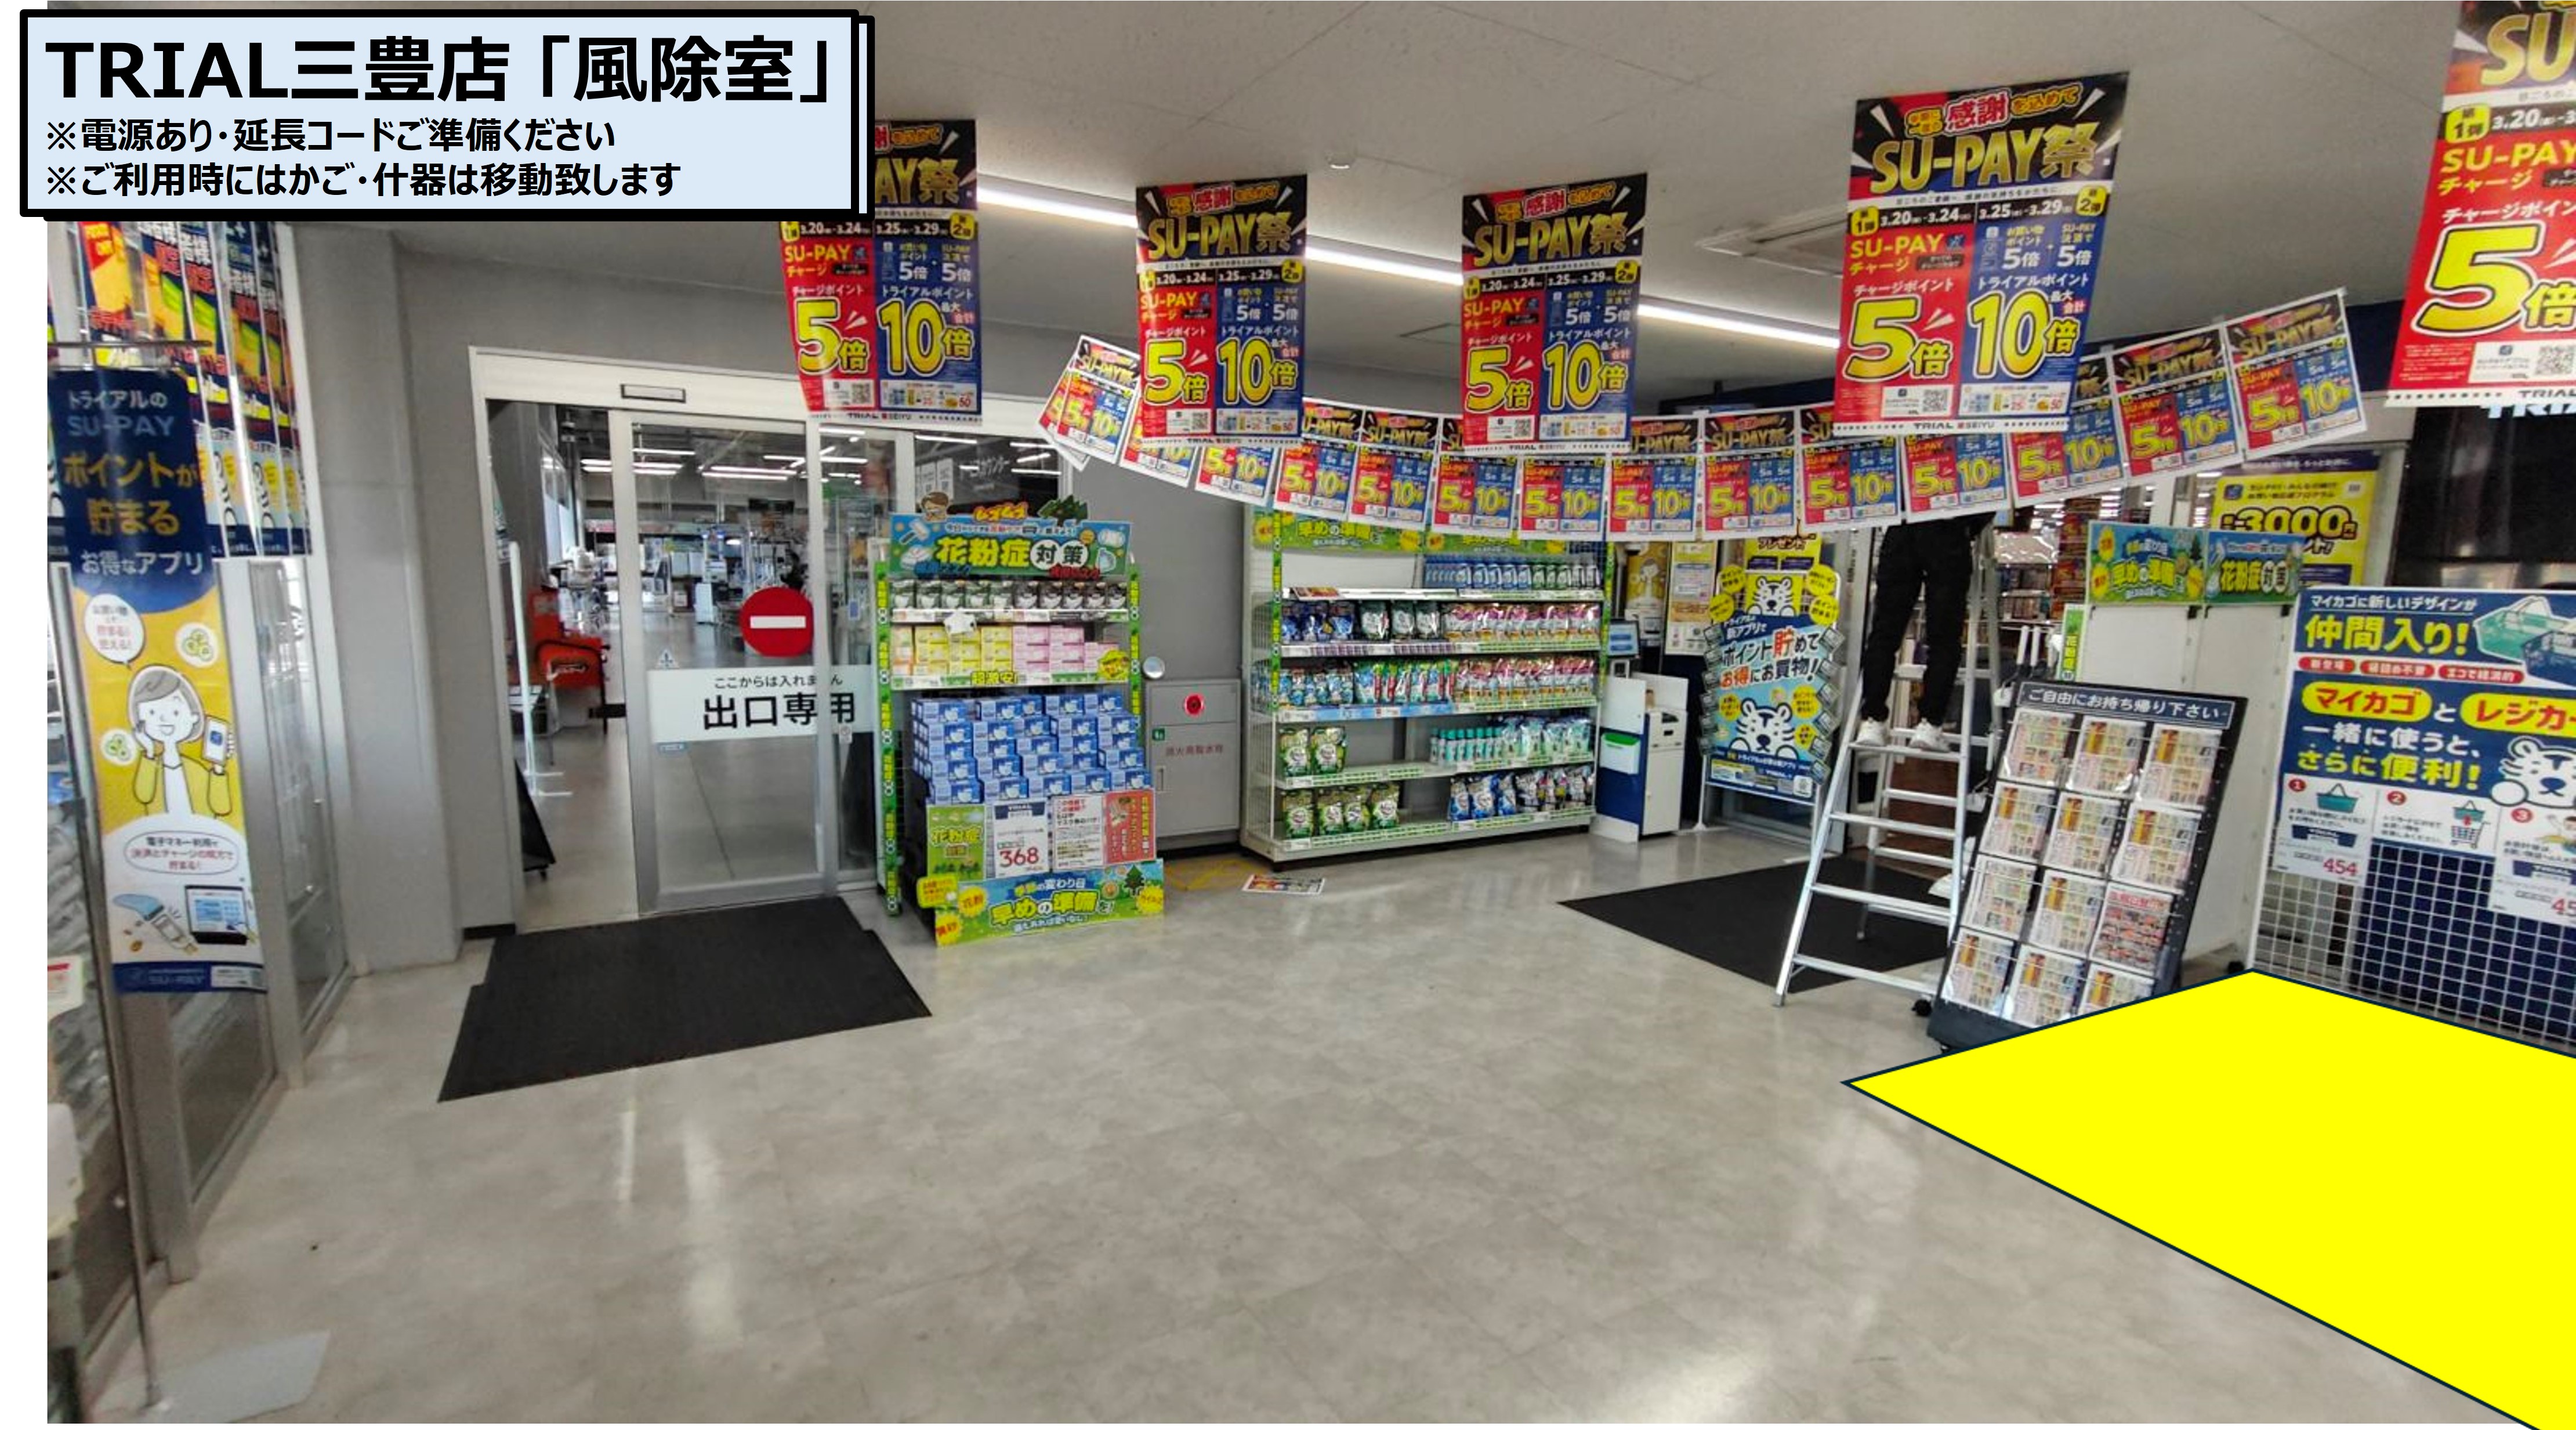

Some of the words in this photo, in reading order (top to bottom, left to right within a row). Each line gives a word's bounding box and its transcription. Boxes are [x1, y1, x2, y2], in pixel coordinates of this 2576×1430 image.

[1871, 122, 2100, 194] SU-PAY祭
[2438, 169, 2533, 196] チャージ
[1148, 212, 1292, 259] SU-PAY祭
[1474, 212, 1628, 267] SU-PAY祭
[1850, 233, 1944, 258] SU-PAY
[785, 244, 851, 262] SU-PAY
[1850, 256, 1910, 276] チャージ
[787, 265, 827, 277] チャージ
[1854, 277, 1954, 296] チャージポイント
[1978, 273, 2089, 289] トライアルポイント
[792, 285, 864, 296] チャージポイント
[882, 284, 973, 298] トライアルポイント
[1141, 292, 1198, 309] SU-PAY
[1463, 298, 1524, 316] SU-PAY
[795, 297, 869, 375] 5倍
[878, 298, 974, 376] 10倍
[1842, 295, 1954, 382] 5倍
[1968, 288, 2081, 379] 10倍
[1144, 338, 1208, 405] 5倍
[1217, 336, 1298, 405] 10倍
[1465, 344, 1533, 414] 5倍
[1542, 339, 1628, 410] 10倍
[68, 390, 167, 409] トライアルの
[67, 415, 175, 436] SU-PAY
[62, 451, 198, 488] ポイントが
[87, 498, 180, 536] 貯まる
[81, 552, 202, 576] お得なアプリ
[2304, 614, 2470, 656] 仲間入り!
[714, 675, 843, 688] ここからは入れまん
[703, 693, 855, 730] 出口専用
[2030, 688, 2219, 719] ご自由にお持ち帰り下さい
[2316, 686, 2421, 716] マイカゴ
[2434, 704, 2457, 722] と
[2298, 750, 2480, 790] さらに便利!
[999, 848, 1039, 867] 368
[2323, 858, 2357, 876] 454
